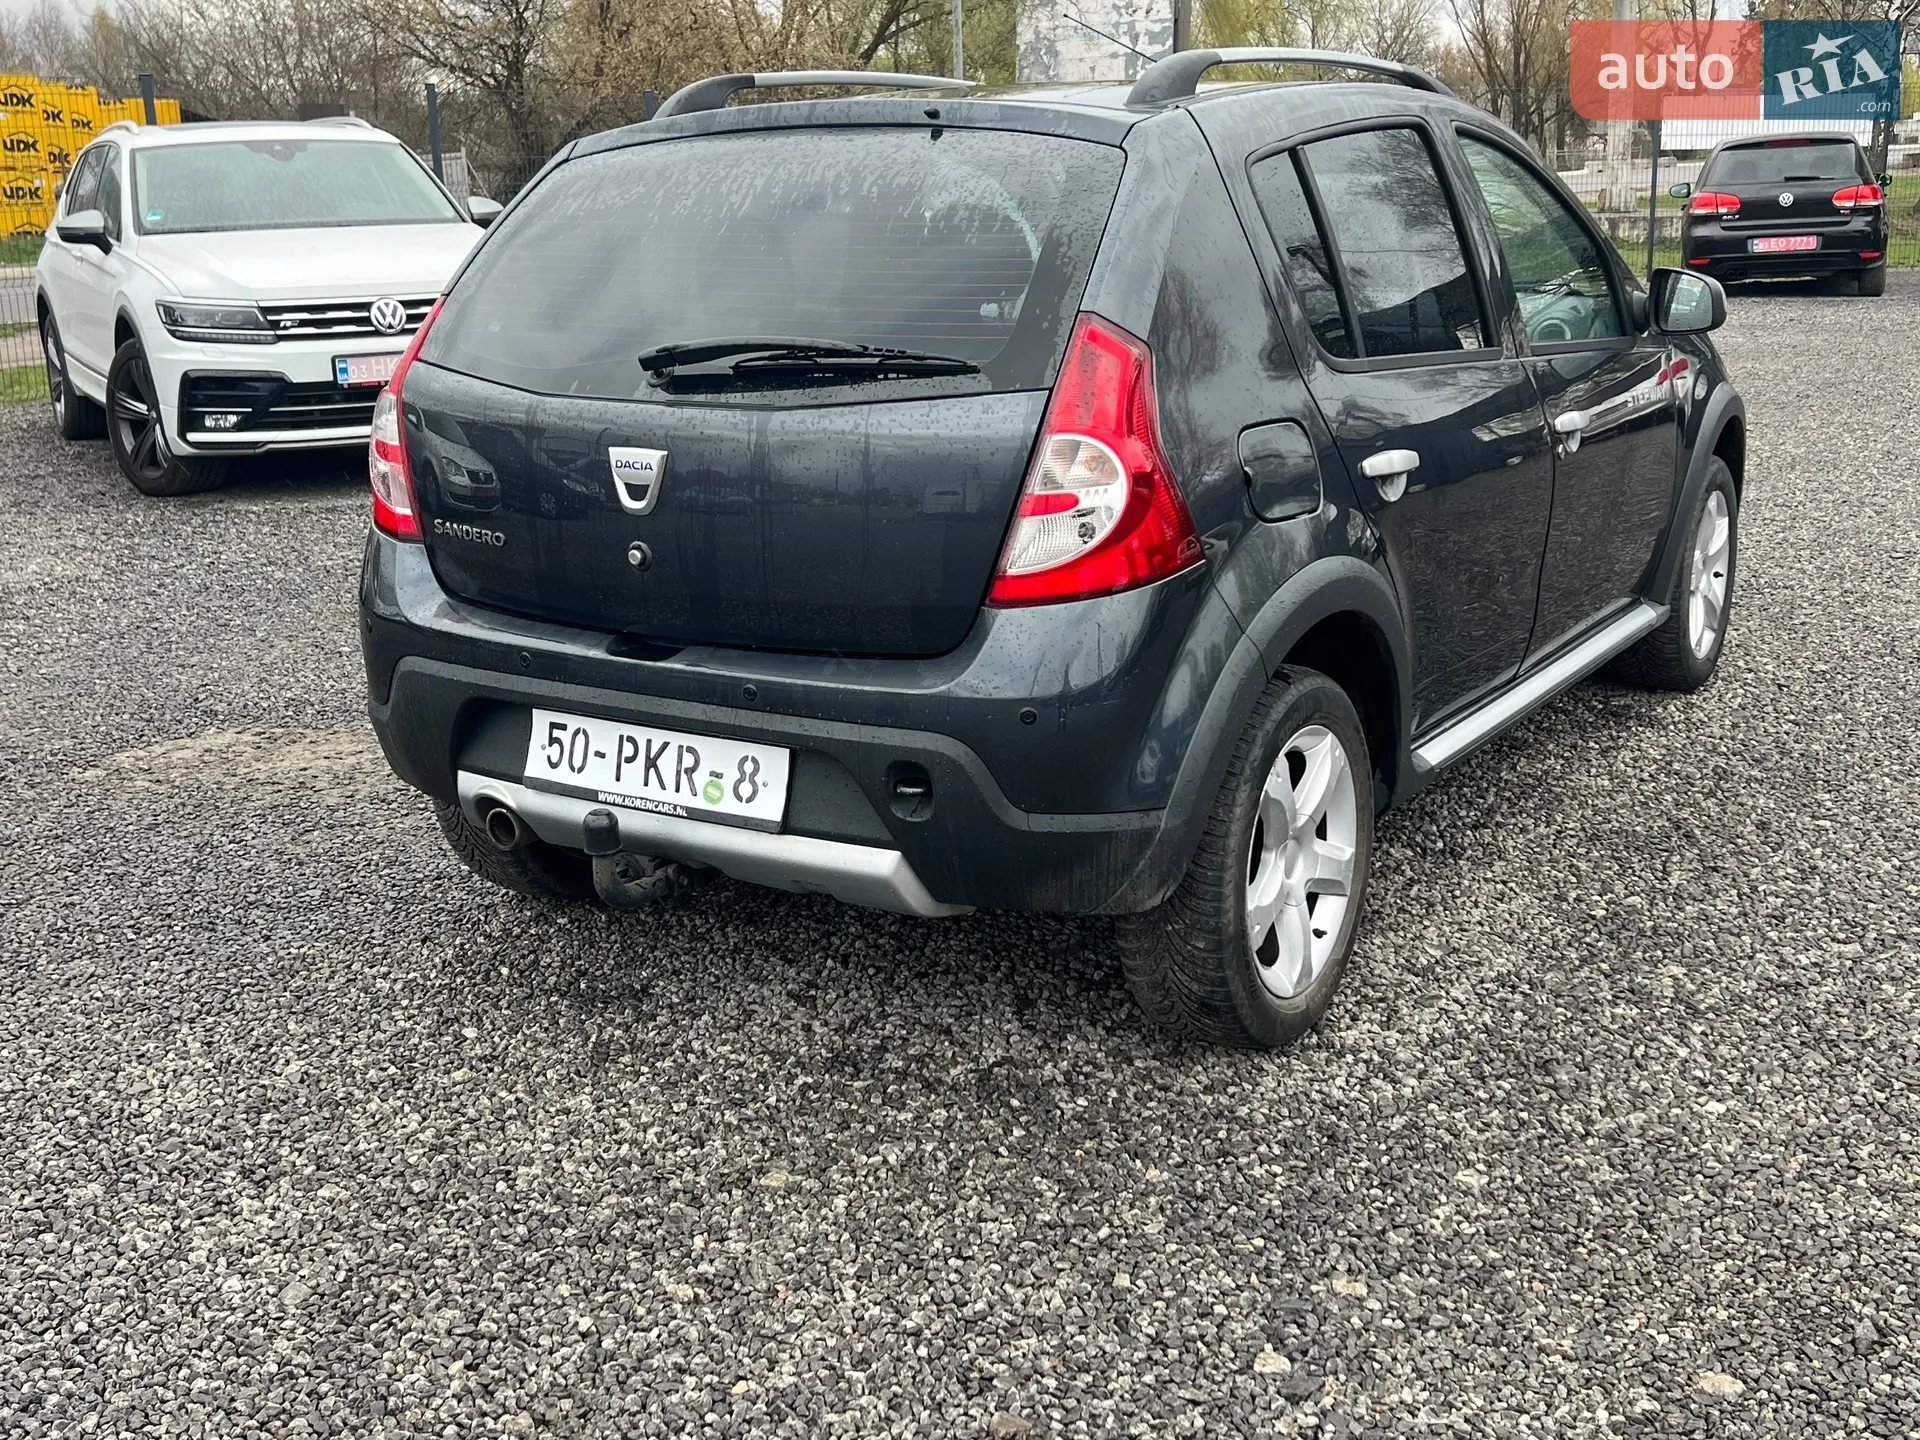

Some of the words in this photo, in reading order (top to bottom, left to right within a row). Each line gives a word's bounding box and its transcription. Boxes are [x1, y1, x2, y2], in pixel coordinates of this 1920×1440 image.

[42, 109, 64, 123] DK
[71, 118, 94, 132] DK
[2, 138, 40, 153] UDK
[48, 151, 72, 166] DK
[2, 186, 43, 200] UDK
[1789, 235, 1813, 248] 7771
[350, 365, 368, 379] 03
[615, 459, 654, 472] DACIA
[433, 518, 506, 547] SANDERO
[546, 721, 761, 804] 50-PKR-8
[598, 791, 688, 817] WWW.KORENCARS.NL
